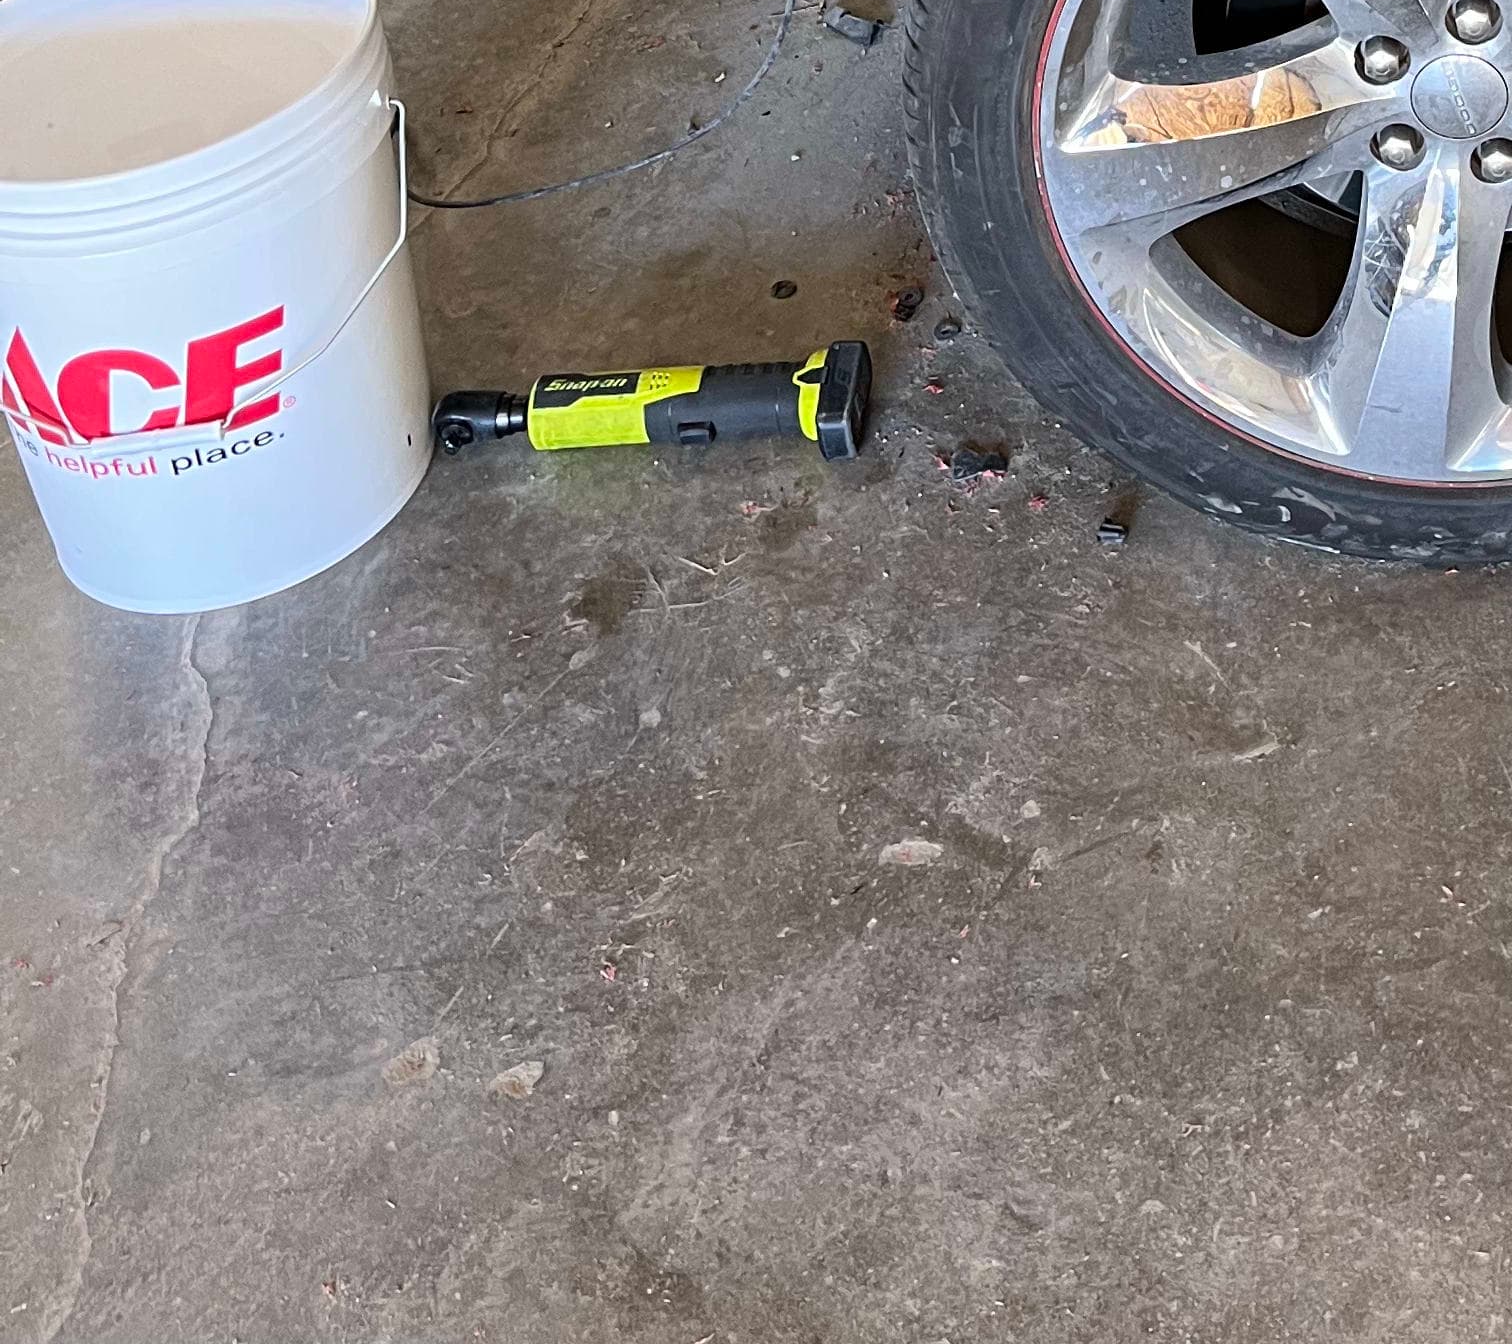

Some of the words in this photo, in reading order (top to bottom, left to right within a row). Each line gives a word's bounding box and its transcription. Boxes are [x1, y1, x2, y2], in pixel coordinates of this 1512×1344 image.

[1, 304, 285, 448] ACE
[44, 446, 158, 479] helpful
[170, 431, 285, 476] place.
